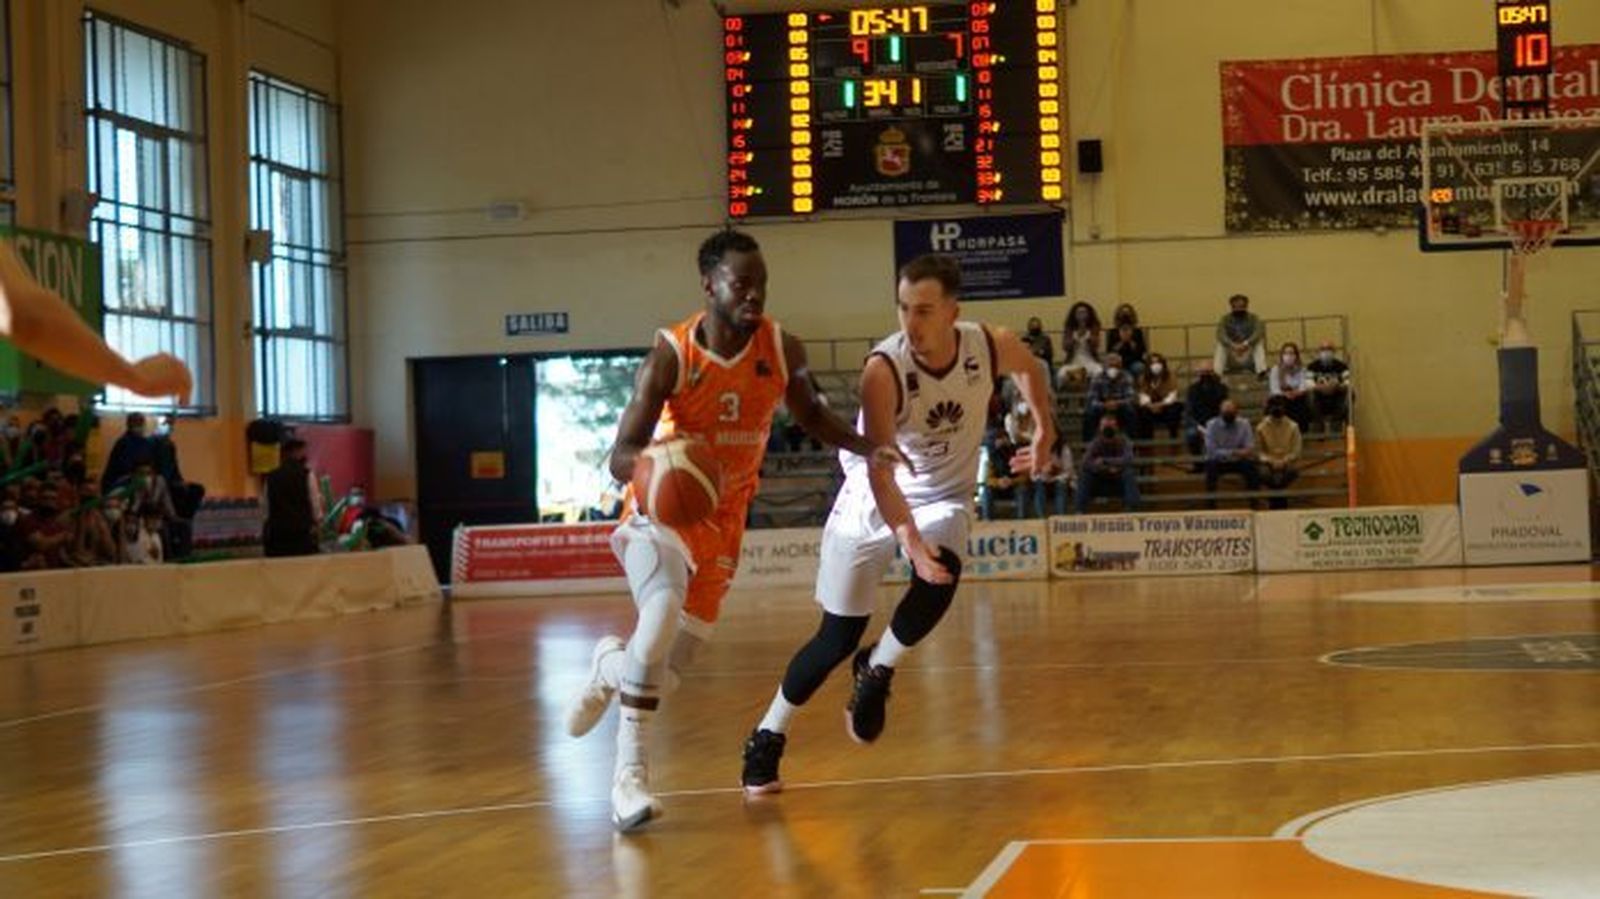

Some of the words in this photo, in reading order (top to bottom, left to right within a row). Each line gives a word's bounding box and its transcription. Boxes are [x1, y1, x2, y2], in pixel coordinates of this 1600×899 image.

[851, 6, 927, 35] 05:47
[1499, 5, 1547, 24] 05:47
[852, 39, 869, 63] 9
[890, 35, 899, 61] 1
[947, 32, 963, 58] 7
[1516, 34, 1548, 67] 10
[844, 81, 854, 107] 1
[956, 75, 966, 102] 1
[1280, 71, 1431, 112] Clínica
[1449, 59, 1600, 104] Dental
[1280, 114, 1351, 142] Dra.
[1364, 110, 1463, 139] Laura
[1331, 147, 1371, 162] Plaza
[1376, 146, 1401, 160] del
[1531, 138, 1549, 152] 14
[1346, 166, 1368, 182] 95
[1374, 164, 1405, 181] 585
[509, 315, 566, 332] SALIDA
[719, 392, 740, 422] 3
[1137, 518, 1182, 533] Troya
[1491, 526, 1563, 539] PRADOVAL
[1142, 537, 1252, 558] TRANSPORTES
